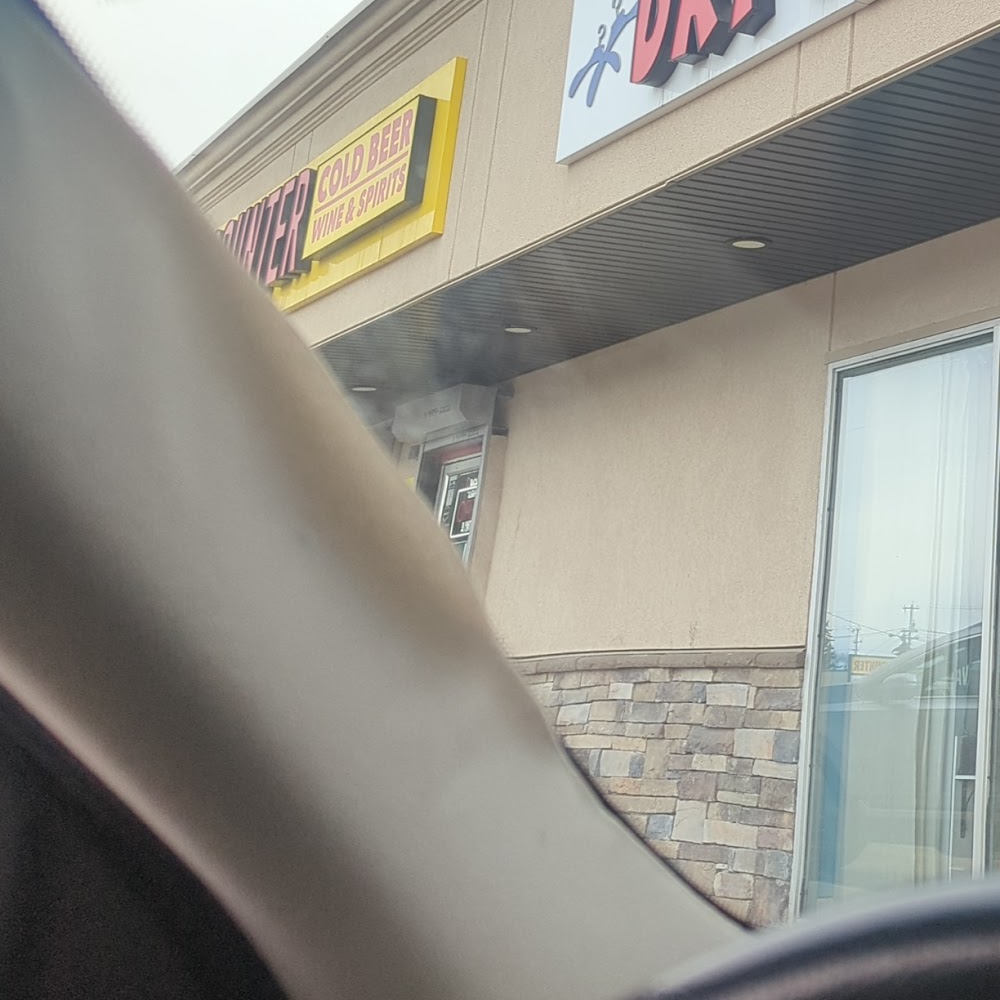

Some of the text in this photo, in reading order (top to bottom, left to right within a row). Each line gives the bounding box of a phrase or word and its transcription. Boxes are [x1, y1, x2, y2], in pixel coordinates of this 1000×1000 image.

[318, 109, 413, 203] COLD BEER
[312, 163, 407, 243] WINE & SPIRITS
